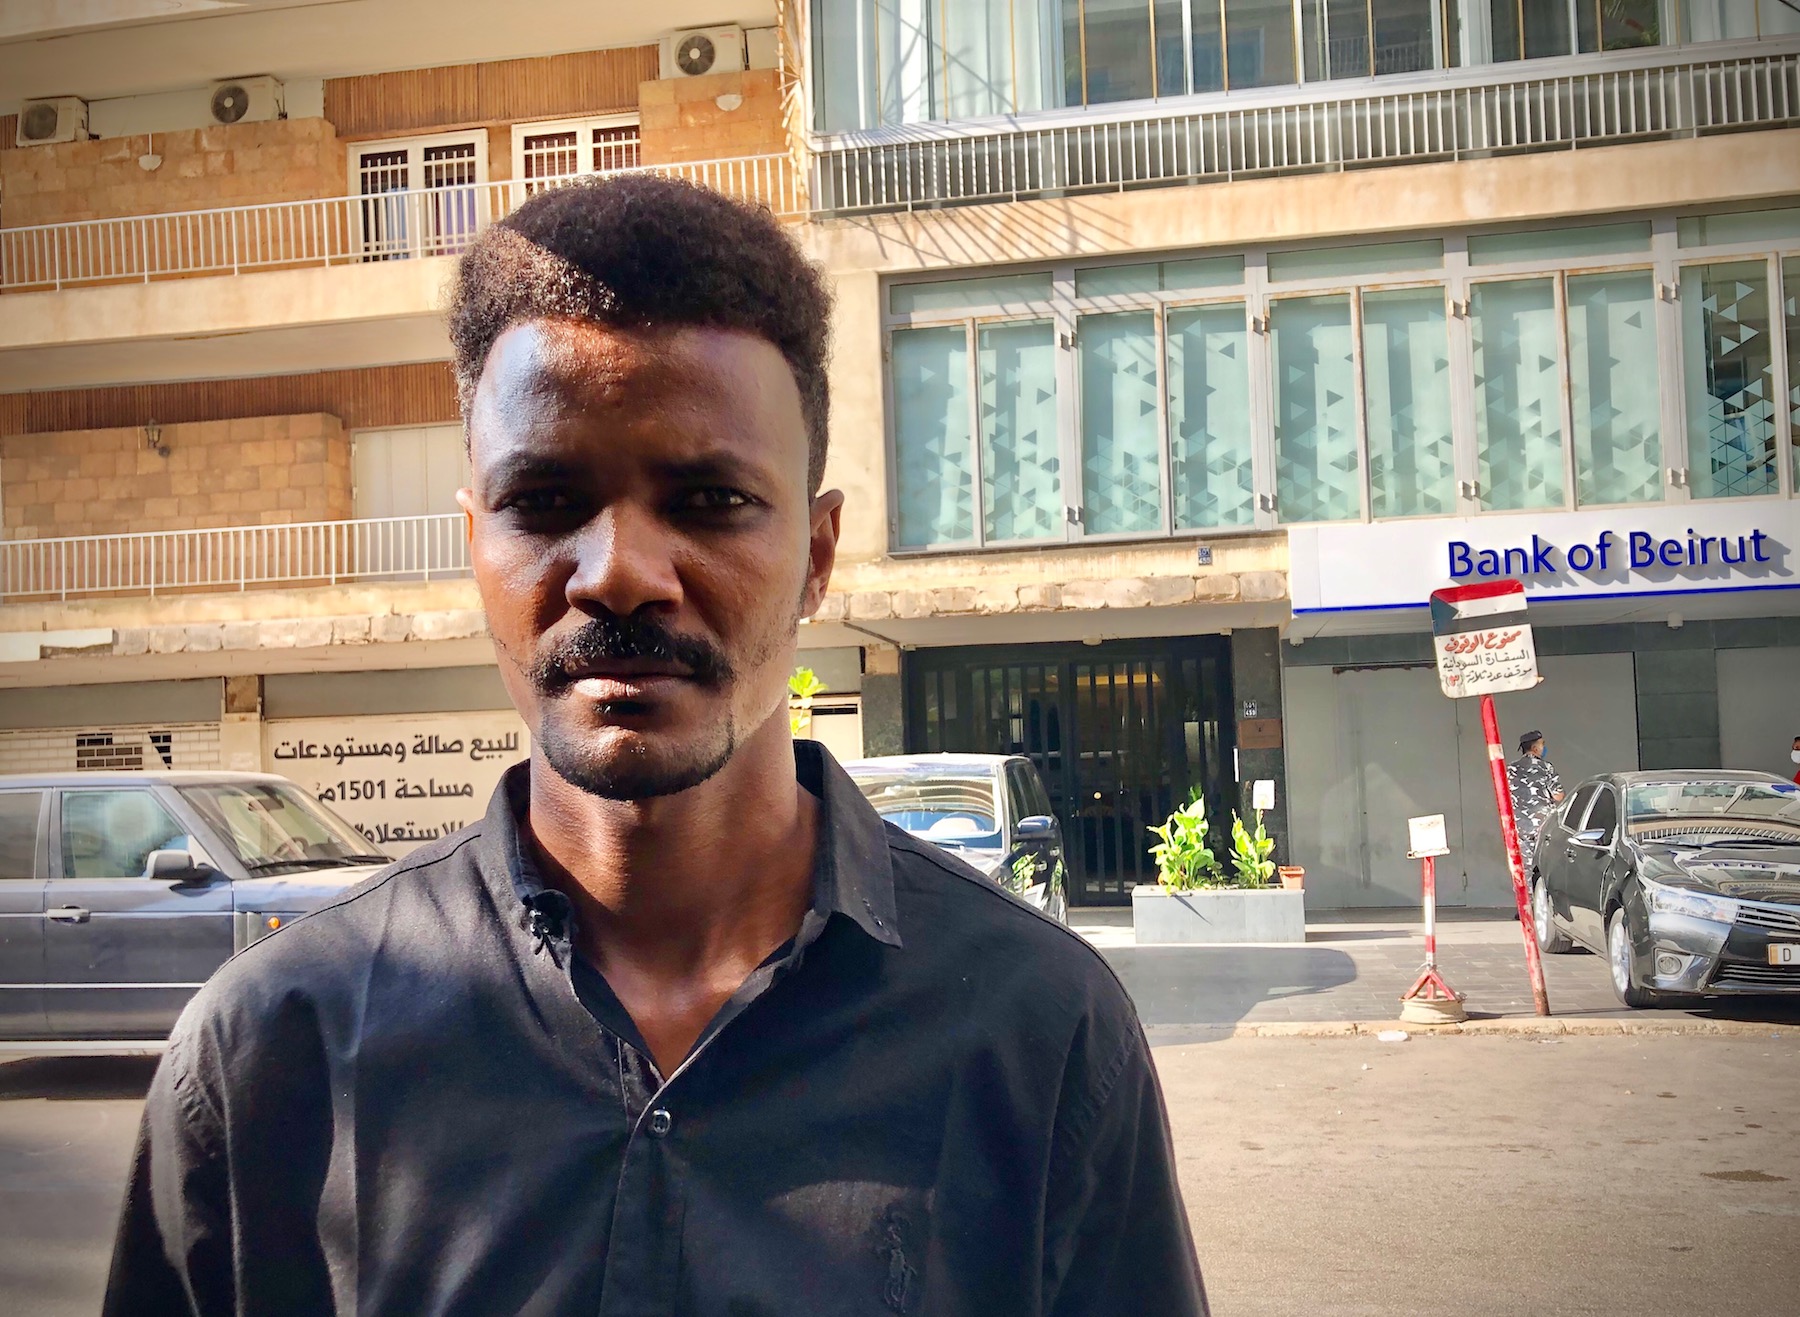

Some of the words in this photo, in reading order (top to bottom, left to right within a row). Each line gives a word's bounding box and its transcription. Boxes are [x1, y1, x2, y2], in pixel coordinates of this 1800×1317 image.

[1448, 534, 1554, 579] Bank
[1566, 530, 1613, 572] of
[1628, 527, 1771, 568] Beirut
[1444, 633, 1484, 654] الوقوف
[1485, 630, 1522, 649] ممنوع
[1443, 655, 1482, 671] السودانية
[1485, 649, 1530, 666] السفارة
[1503, 665, 1532, 678] موقف
[274, 737, 407, 765] ومستودعات
[412, 734, 465, 756] صالة
[469, 731, 520, 761] للبيع
[394, 778, 475, 799] مساحة
[1783, 947, 1792, 962] D
